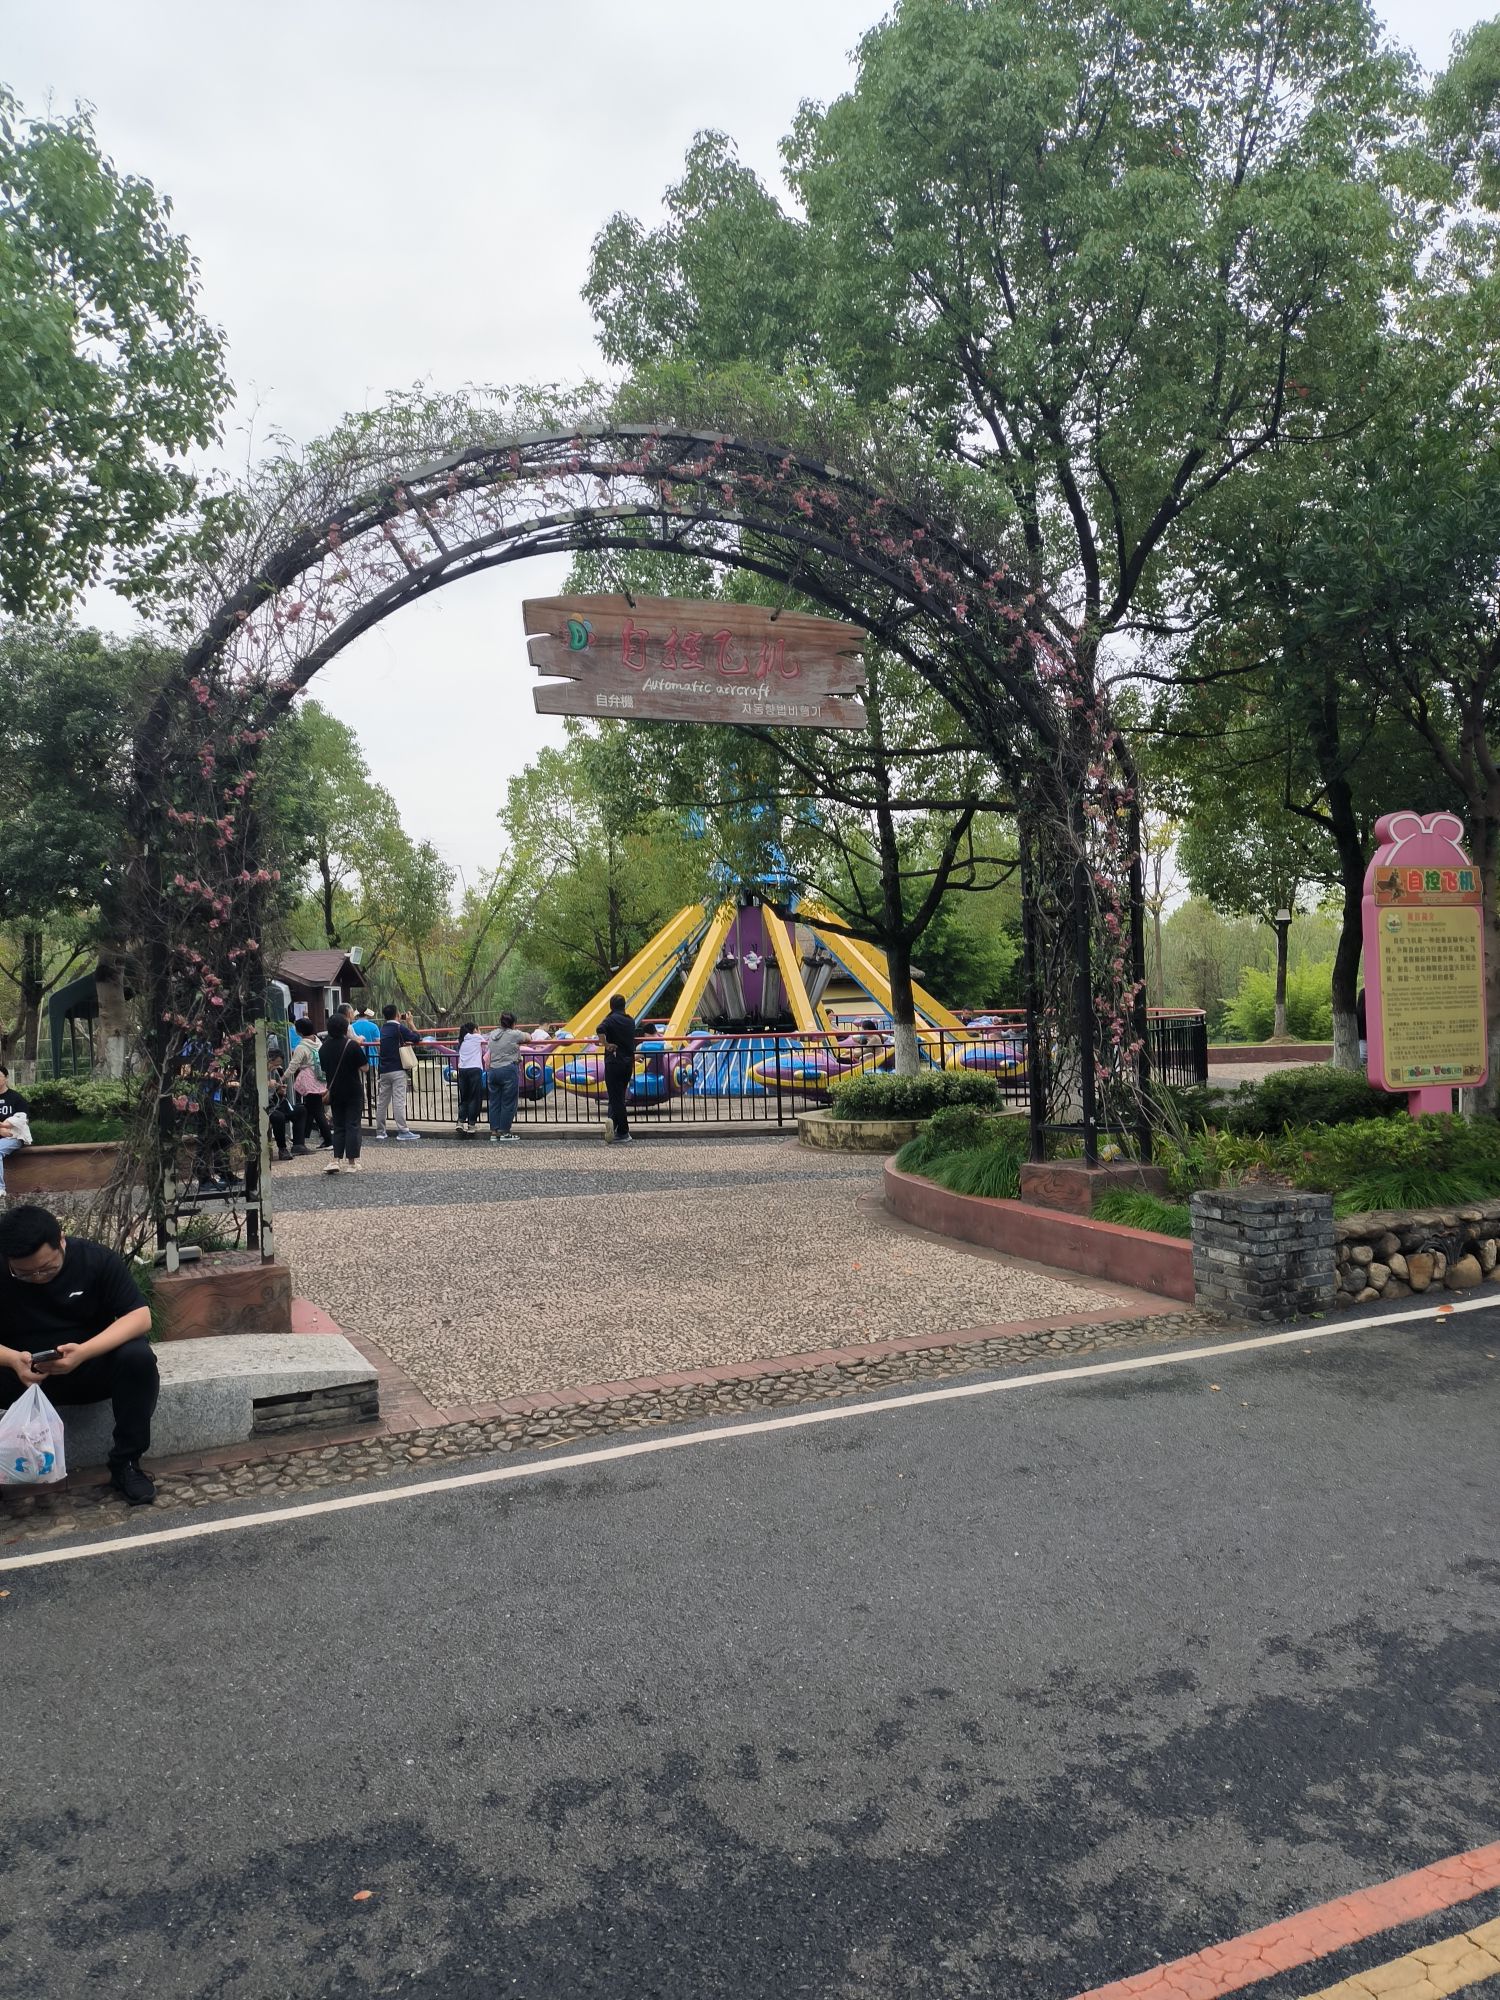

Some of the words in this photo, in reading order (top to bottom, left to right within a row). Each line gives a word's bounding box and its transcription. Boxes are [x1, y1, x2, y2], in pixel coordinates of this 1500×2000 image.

[641, 677, 712, 694] Automatic
[1408, 869, 1476, 892] 自控飞机
